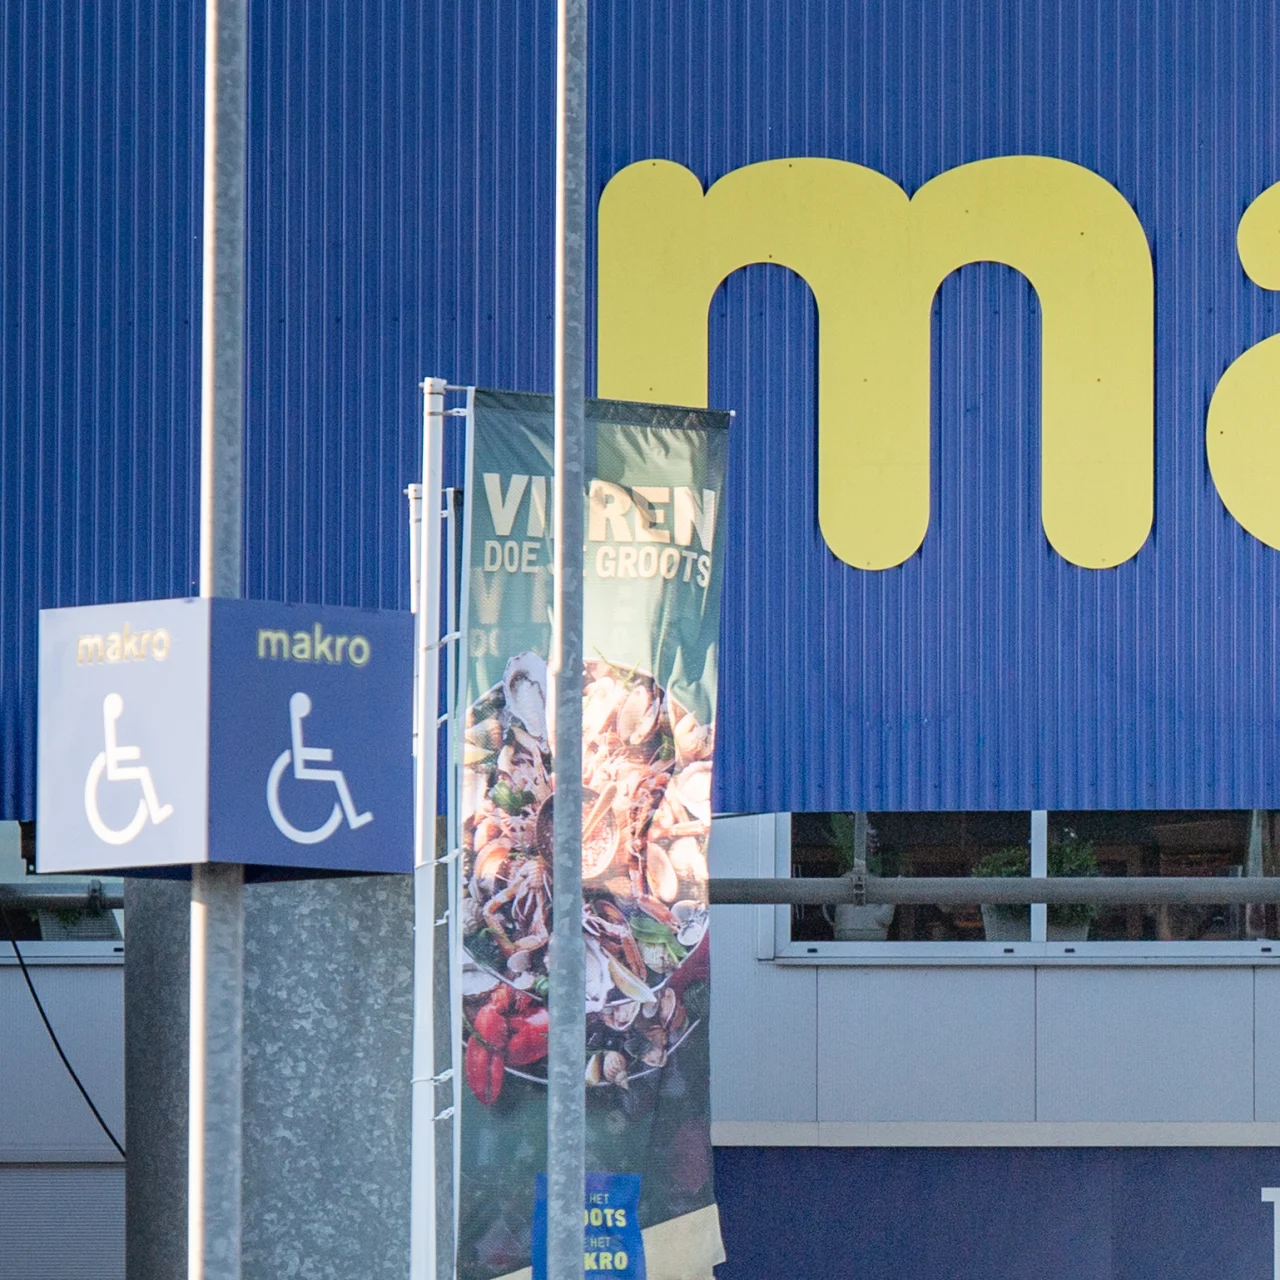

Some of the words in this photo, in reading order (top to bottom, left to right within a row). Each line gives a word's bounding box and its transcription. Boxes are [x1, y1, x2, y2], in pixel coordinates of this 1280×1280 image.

[483, 473, 716, 553] VIREN
[484, 540, 541, 573] DOE
[595, 546, 712, 588] GROOTS
[77, 621, 170, 665] makro
[258, 622, 371, 666] makro
[590, 1193, 609, 1205] HET
[584, 1252, 628, 1270] KRO
[590, 1236, 610, 1248] HET
